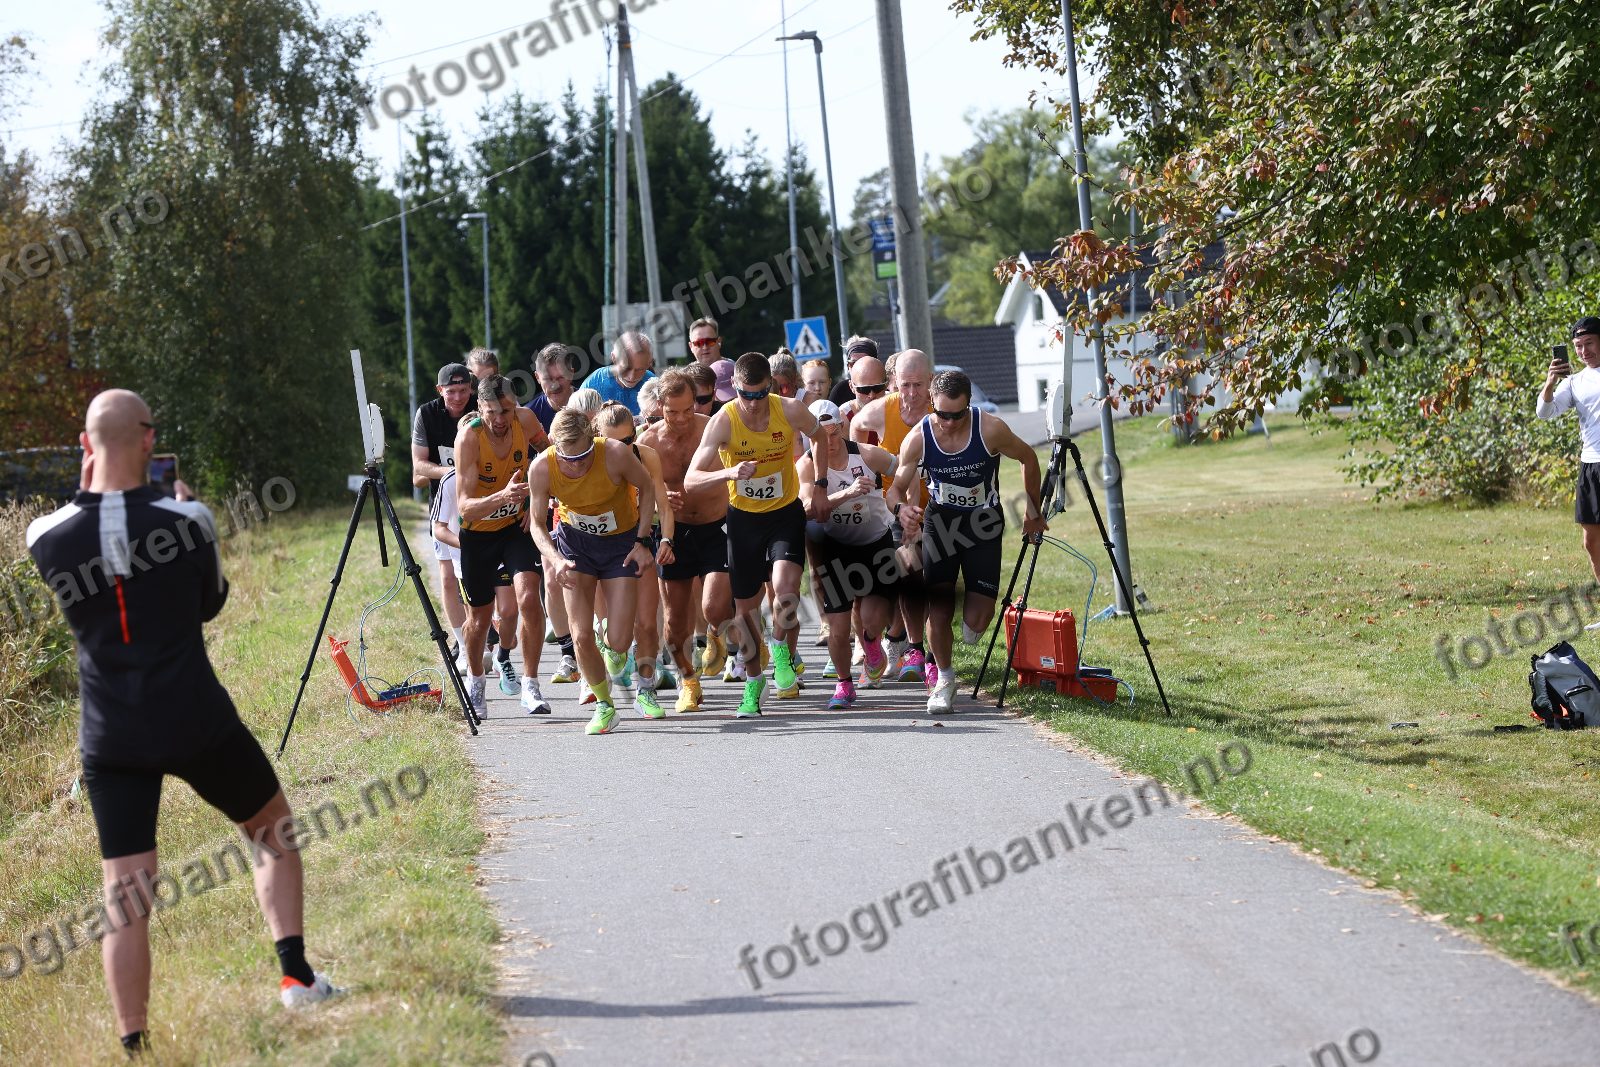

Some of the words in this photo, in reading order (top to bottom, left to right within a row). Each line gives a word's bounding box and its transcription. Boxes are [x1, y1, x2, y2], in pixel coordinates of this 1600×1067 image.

[745, 486, 775, 499] 942
[947, 493, 978, 507] 993
[832, 512, 863, 524] 976
[578, 521, 609, 533] 992
